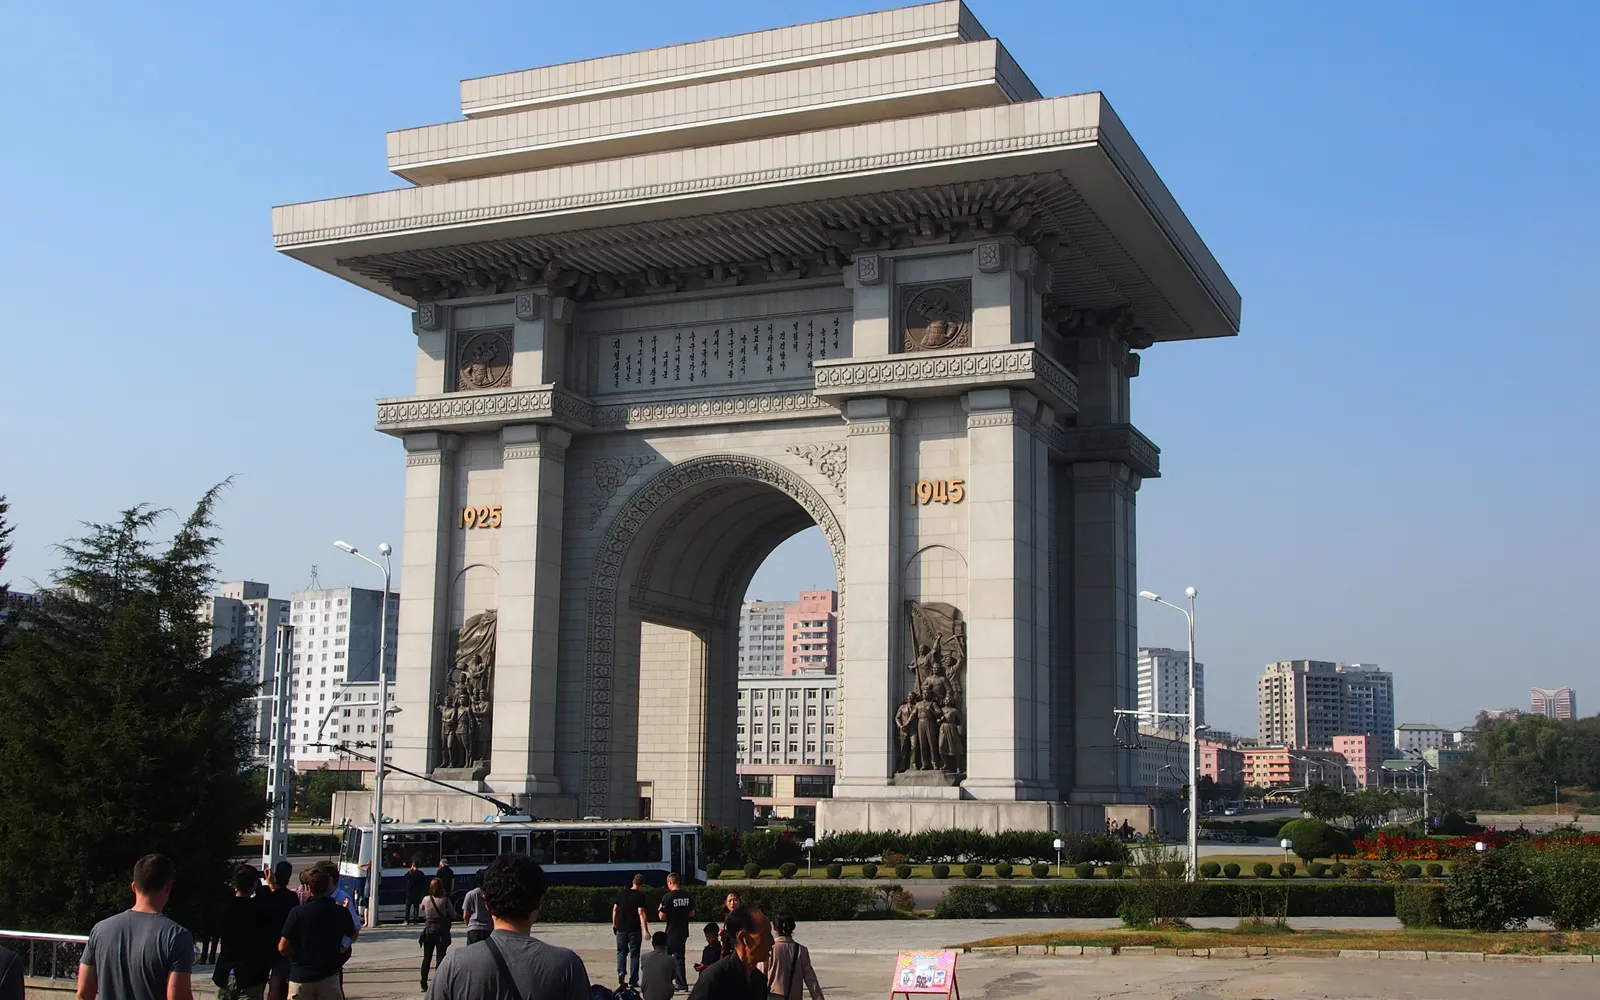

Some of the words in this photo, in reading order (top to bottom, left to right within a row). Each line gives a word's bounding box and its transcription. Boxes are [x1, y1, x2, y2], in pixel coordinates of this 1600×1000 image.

[910, 480, 965, 512] 1945
[458, 506, 503, 530] 1925
[673, 898, 690, 907] STAFF
